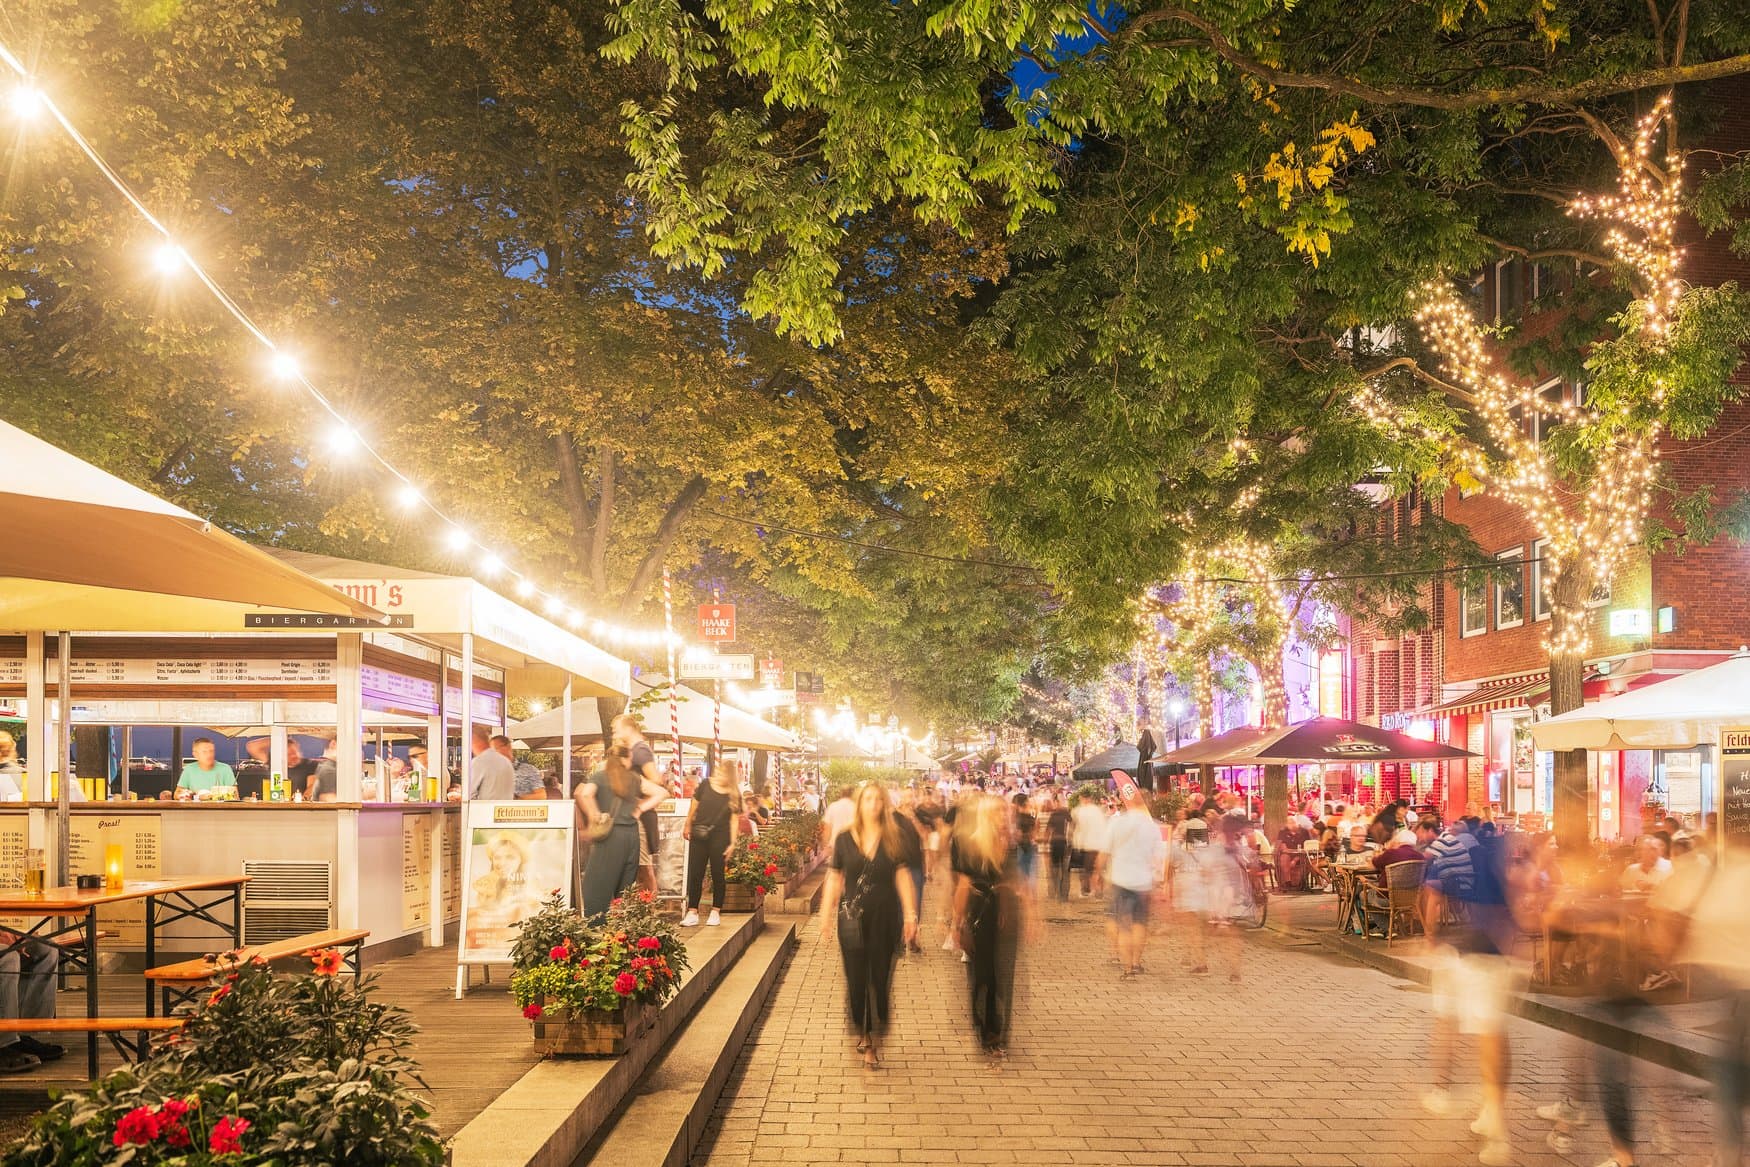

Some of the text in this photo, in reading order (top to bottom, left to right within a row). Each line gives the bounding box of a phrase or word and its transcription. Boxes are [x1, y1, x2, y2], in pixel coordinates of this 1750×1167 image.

[255, 617, 403, 625] BIERGARTN
[702, 618, 731, 628] HAAKE
[705, 628, 728, 637] BECK
[683, 663, 750, 671] BIERGTEN
[1322, 744, 1391, 753] BECK'S
[497, 807, 545, 818] feldmann's
[98, 819, 121, 829] Prost!
